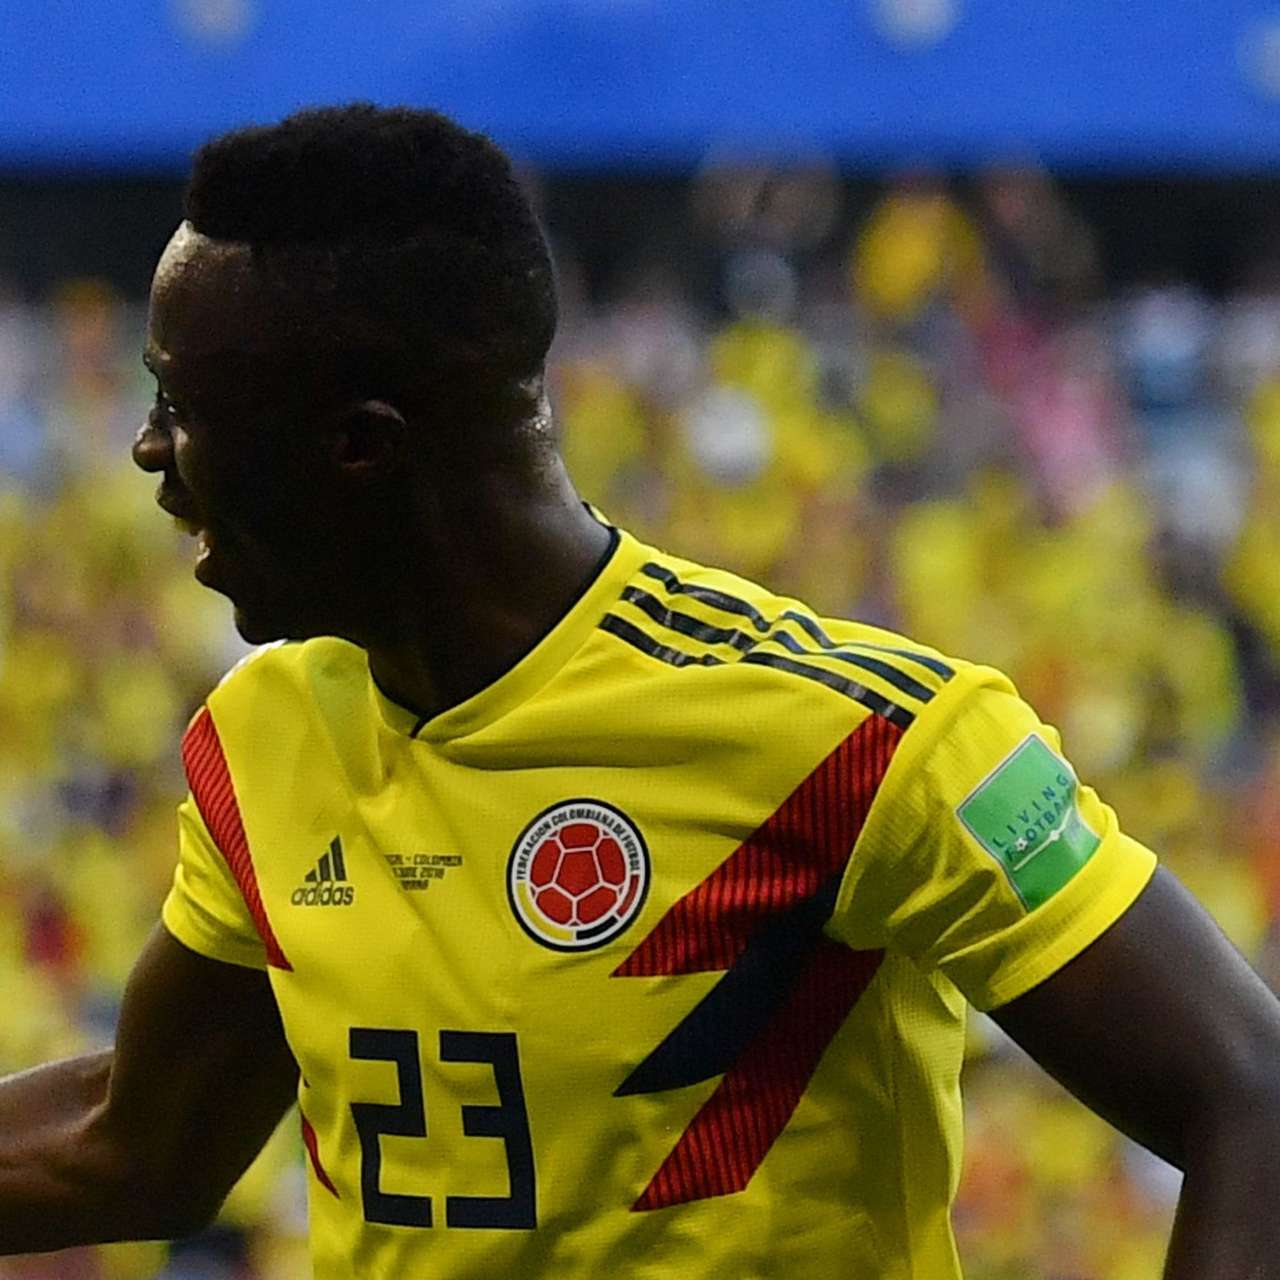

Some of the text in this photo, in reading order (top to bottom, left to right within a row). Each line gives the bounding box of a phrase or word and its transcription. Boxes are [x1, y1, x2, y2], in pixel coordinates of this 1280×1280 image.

[992, 773, 1070, 848] LIVING
[291, 881, 354, 906] adidas
[349, 1027, 537, 1229] 23
